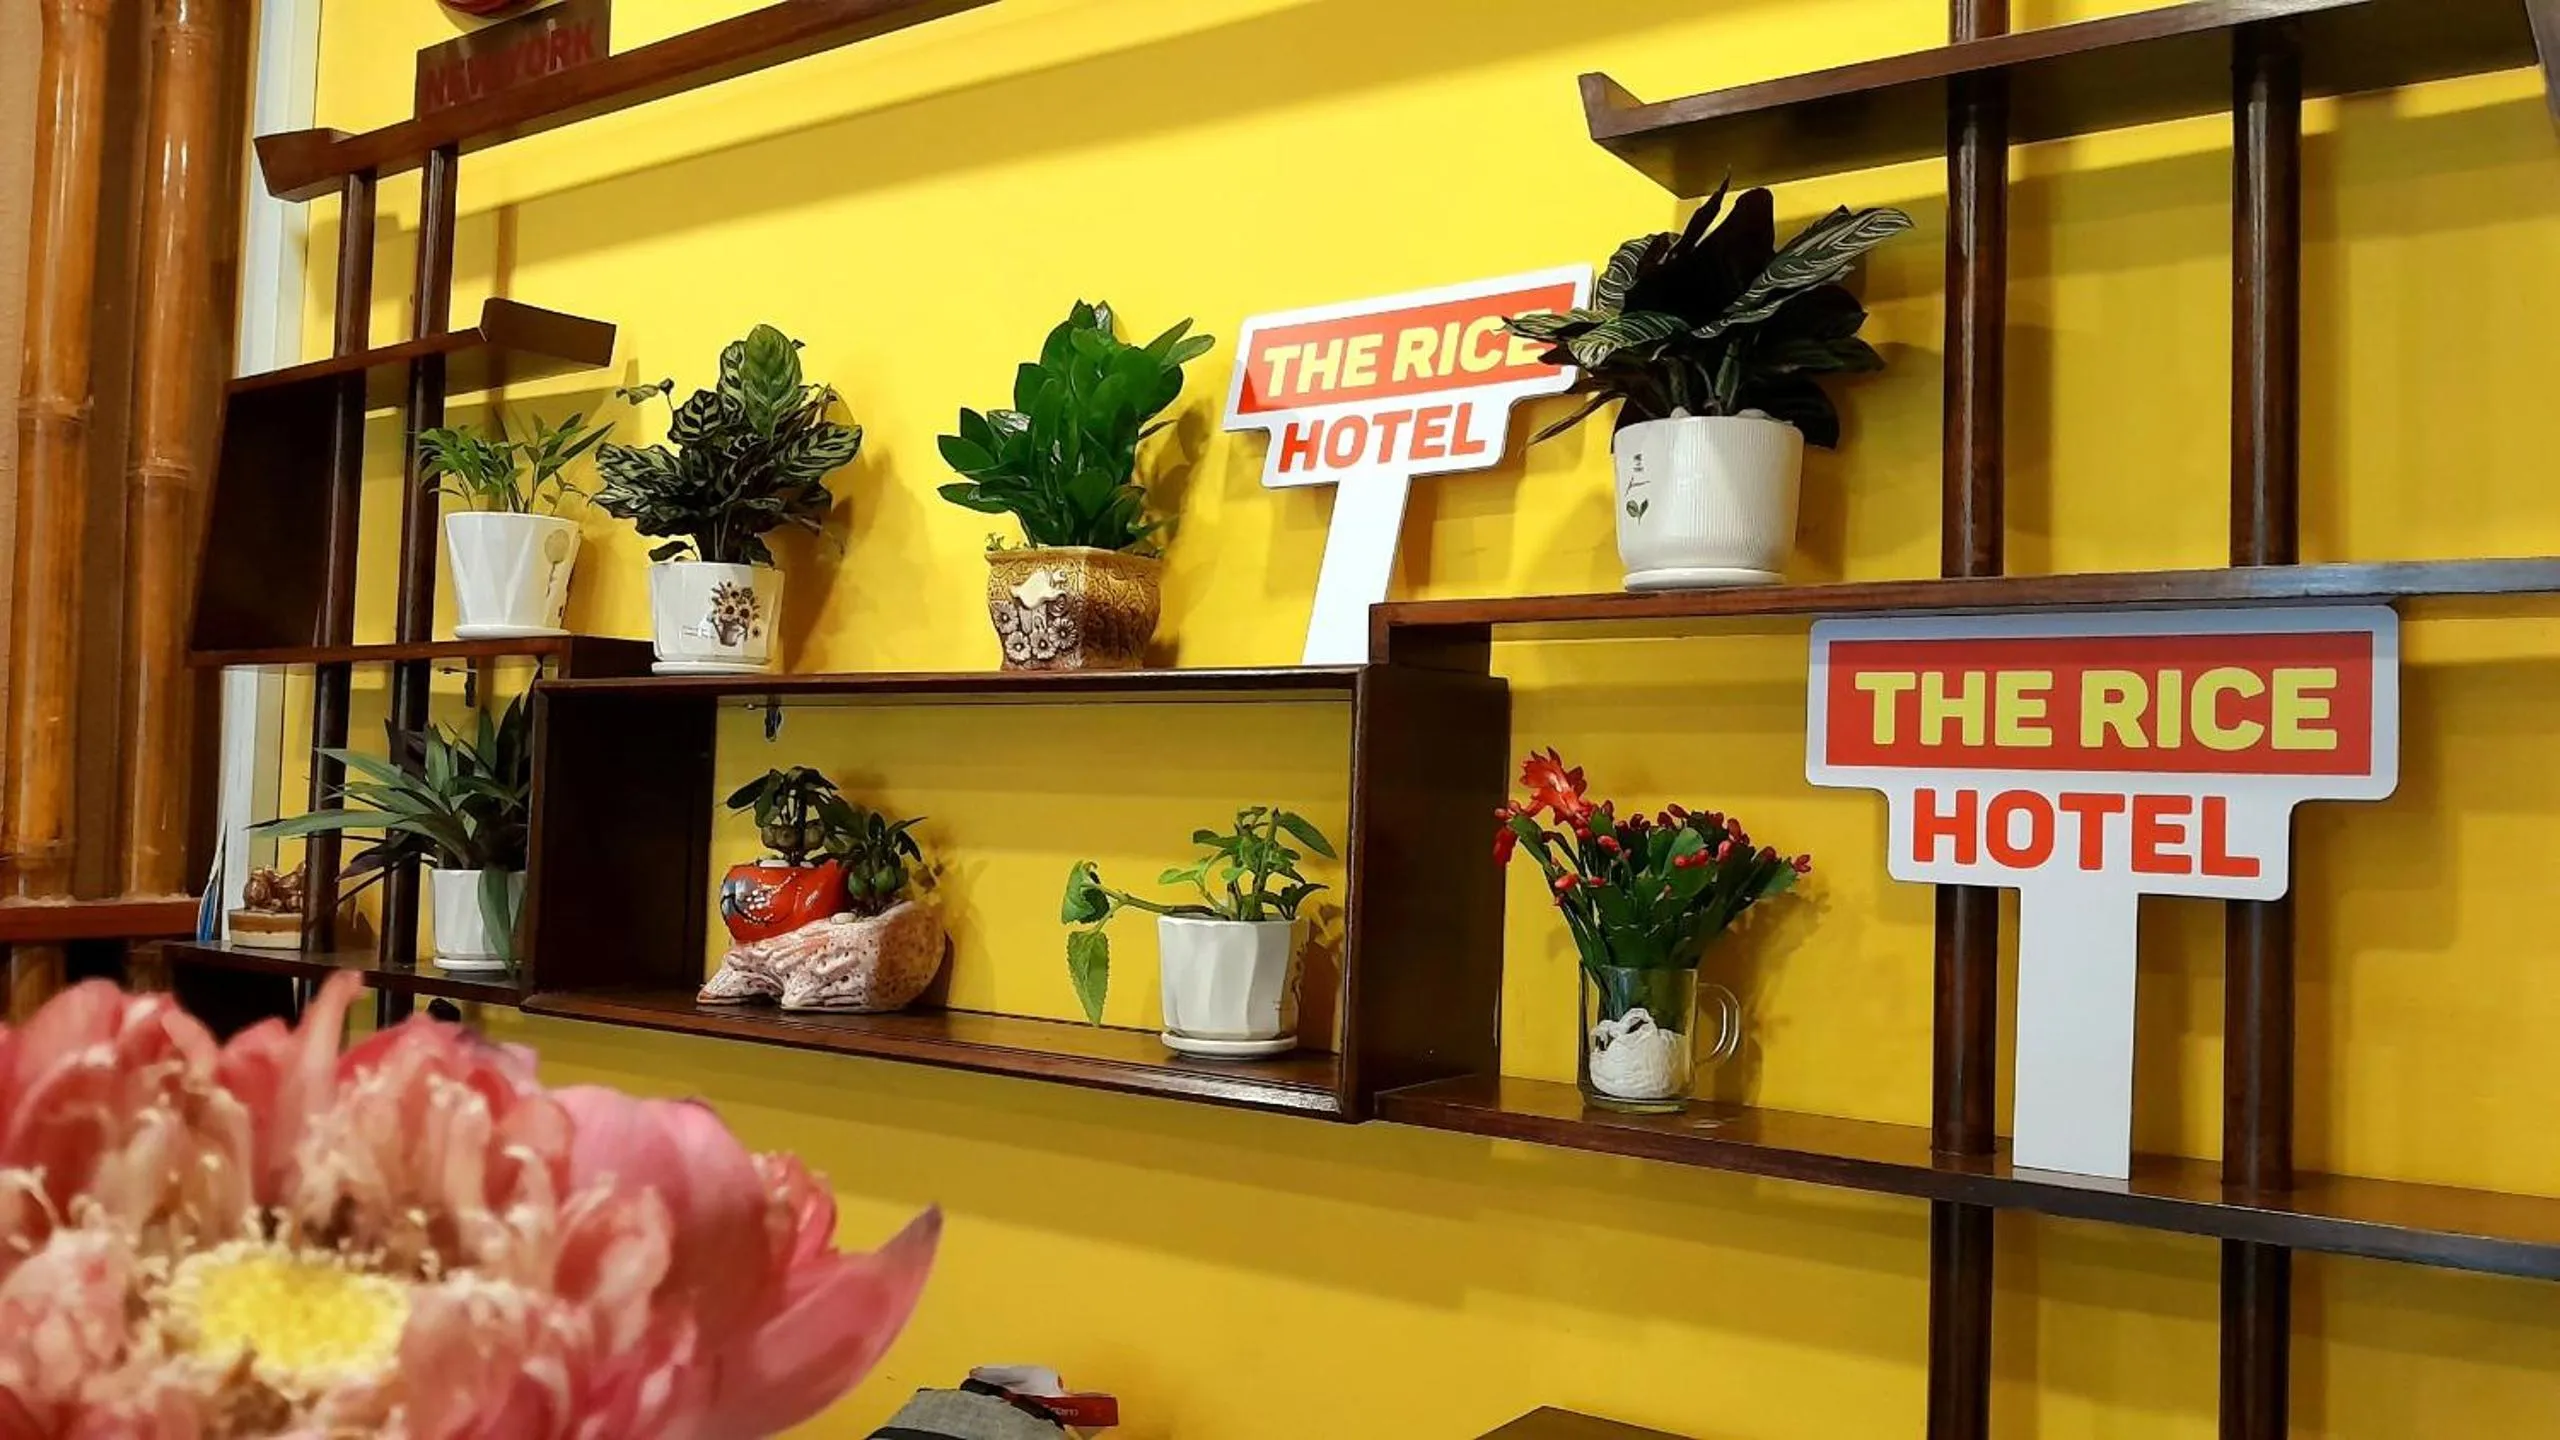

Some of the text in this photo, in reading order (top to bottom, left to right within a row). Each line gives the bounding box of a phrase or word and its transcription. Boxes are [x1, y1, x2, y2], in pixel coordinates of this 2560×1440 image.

[1263, 333, 1384, 398] THE
[1277, 402, 1486, 473] HOTEL
[1854, 666, 2338, 751] THE RICE
[1912, 788, 2261, 878] HOTEL
